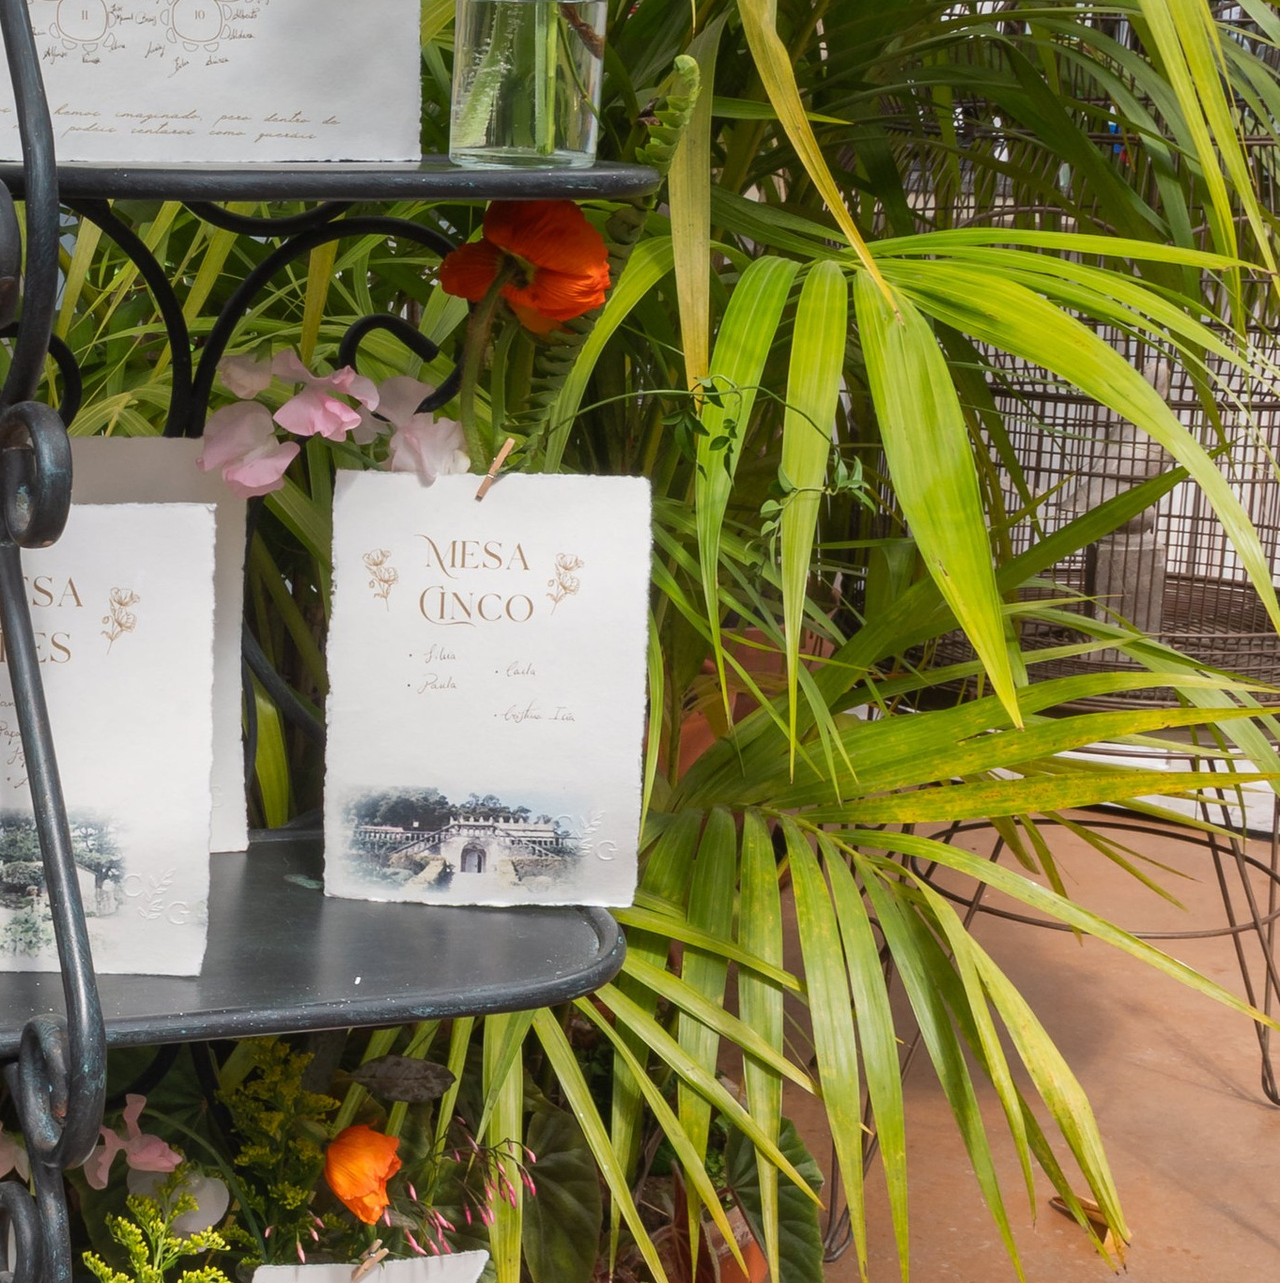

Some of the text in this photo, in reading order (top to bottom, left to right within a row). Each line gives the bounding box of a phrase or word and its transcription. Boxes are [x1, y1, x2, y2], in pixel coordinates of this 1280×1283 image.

[194, 10, 206, 20] 10
[53, 103, 101, 117] hemos
[212, 114, 252, 128] pero
[264, 111, 311, 124] dentro
[321, 116, 340, 125] de
[130, 122, 196, 136] sentaros
[209, 129, 246, 137] como
[415, 533, 531, 579] MESA
[419, 585, 535, 627] CINCO
